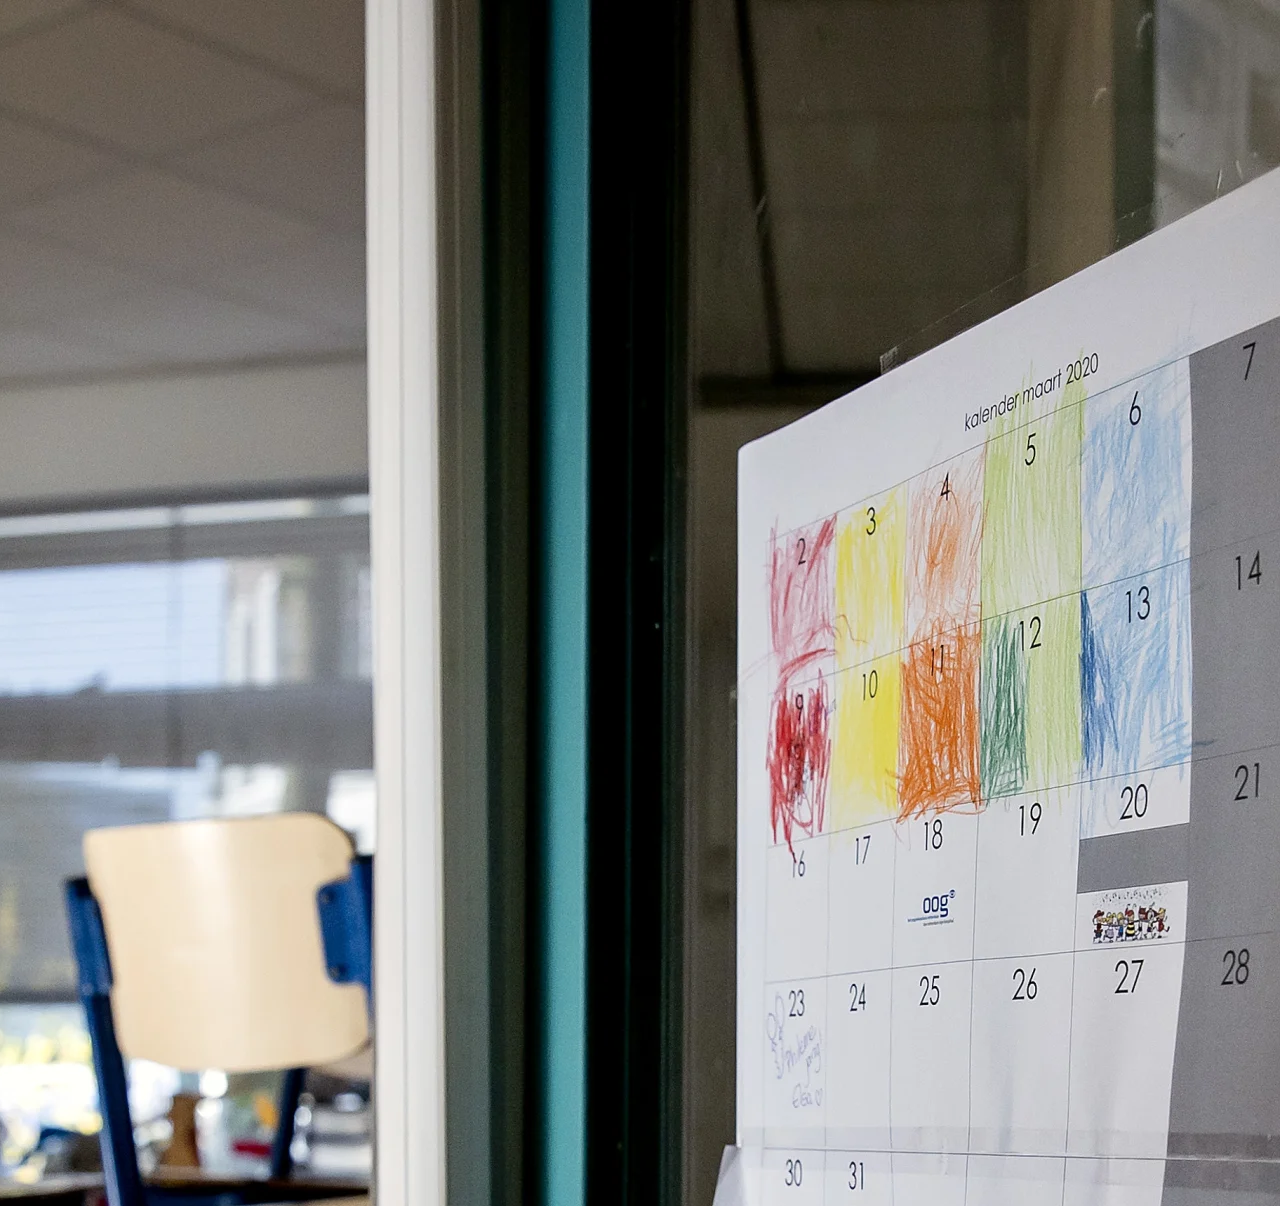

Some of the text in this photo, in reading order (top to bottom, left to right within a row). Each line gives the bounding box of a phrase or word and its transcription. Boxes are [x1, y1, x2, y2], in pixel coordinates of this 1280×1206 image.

[1242, 341, 1256, 381] 7
[963, 352, 1099, 432] kalender maart 2020
[1129, 390, 1142, 426] 6
[1024, 432, 1037, 466] 5
[940, 472, 951, 501] 4
[866, 506, 876, 536] 3
[797, 537, 807, 566] 2
[1235, 550, 1262, 591] 14
[1125, 585, 1151, 624] 13
[1019, 616, 1042, 652] 12
[931, 644, 945, 676] 11
[862, 669, 878, 699] 10
[1234, 762, 1260, 801] 21
[1119, 783, 1148, 820] 20
[924, 819, 943, 851] 18
[1019, 802, 1042, 836] 19
[855, 835, 872, 866] 17
[1012, 967, 1038, 1001] 26
[1114, 959, 1145, 994] 27
[1220, 948, 1250, 986] 28
[789, 989, 804, 1017] 23
[850, 983, 866, 1012] 24
[919, 975, 940, 1006] 25
[785, 1159, 801, 1187] 30
[849, 1161, 864, 1190] 31
